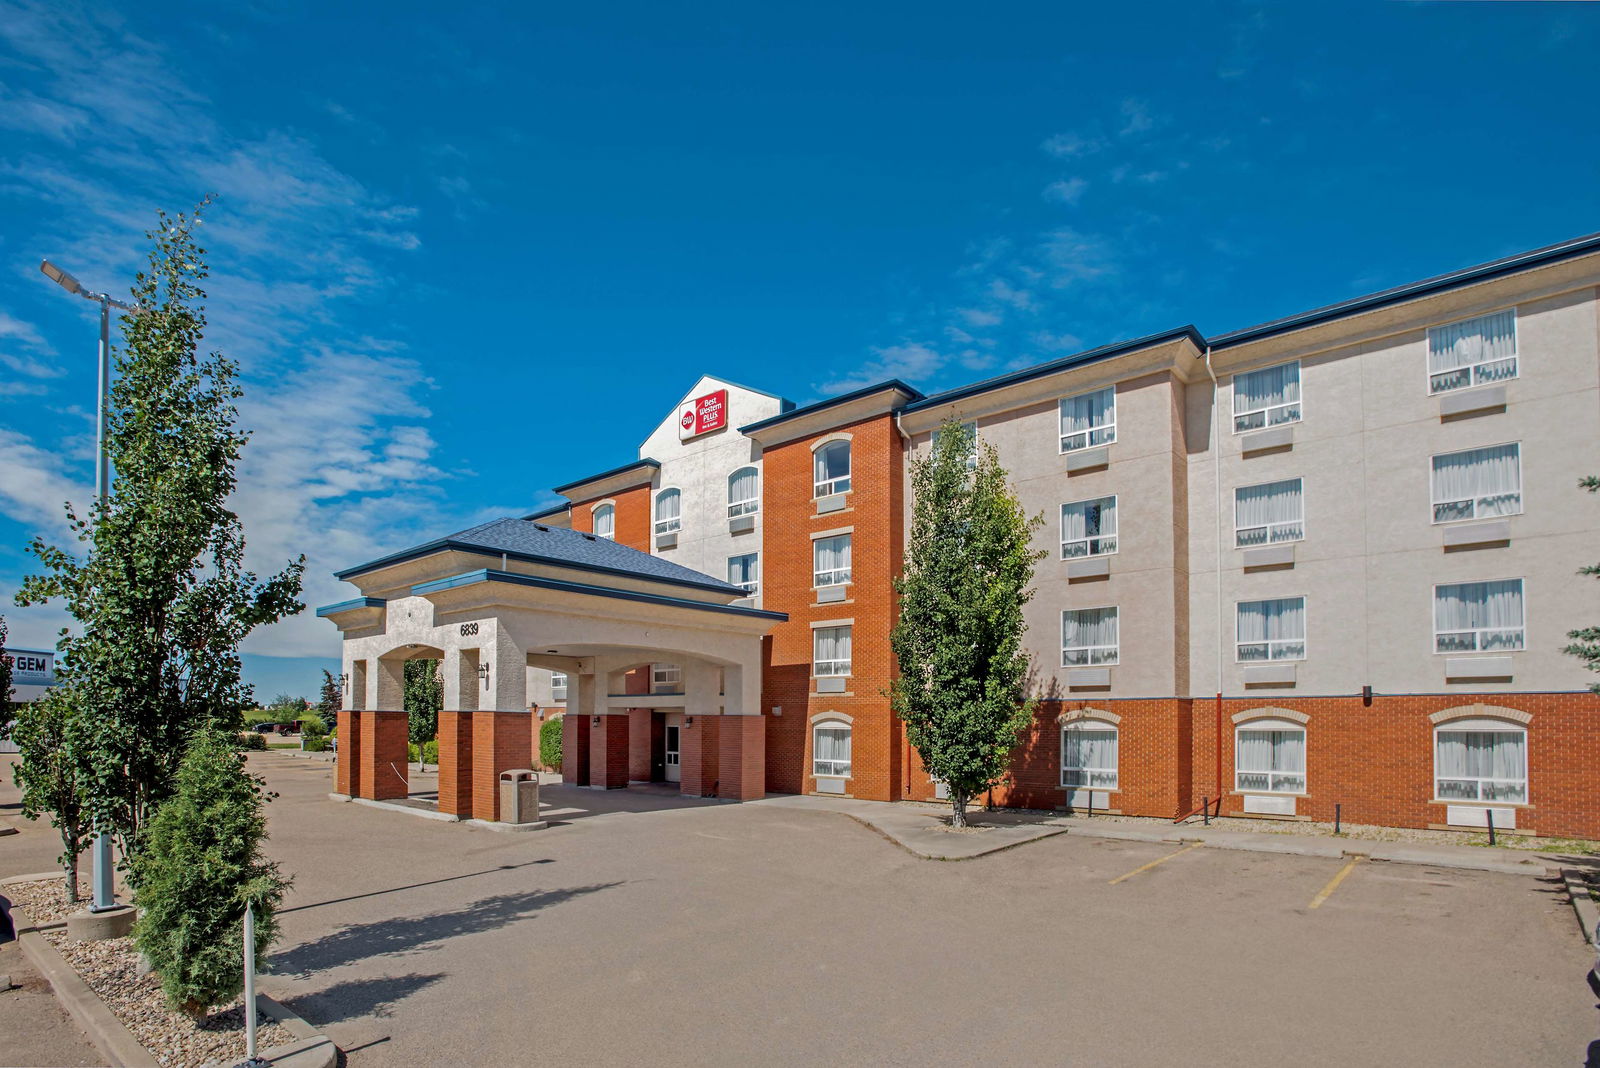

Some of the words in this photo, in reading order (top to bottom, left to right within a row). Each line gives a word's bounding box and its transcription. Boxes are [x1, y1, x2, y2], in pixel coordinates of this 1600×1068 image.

[704, 397, 717, 407] Best
[700, 403, 722, 415] Western
[703, 411, 718, 422] PLUS
[460, 622, 478, 636] 6839
[17, 656, 46, 671] GEM
